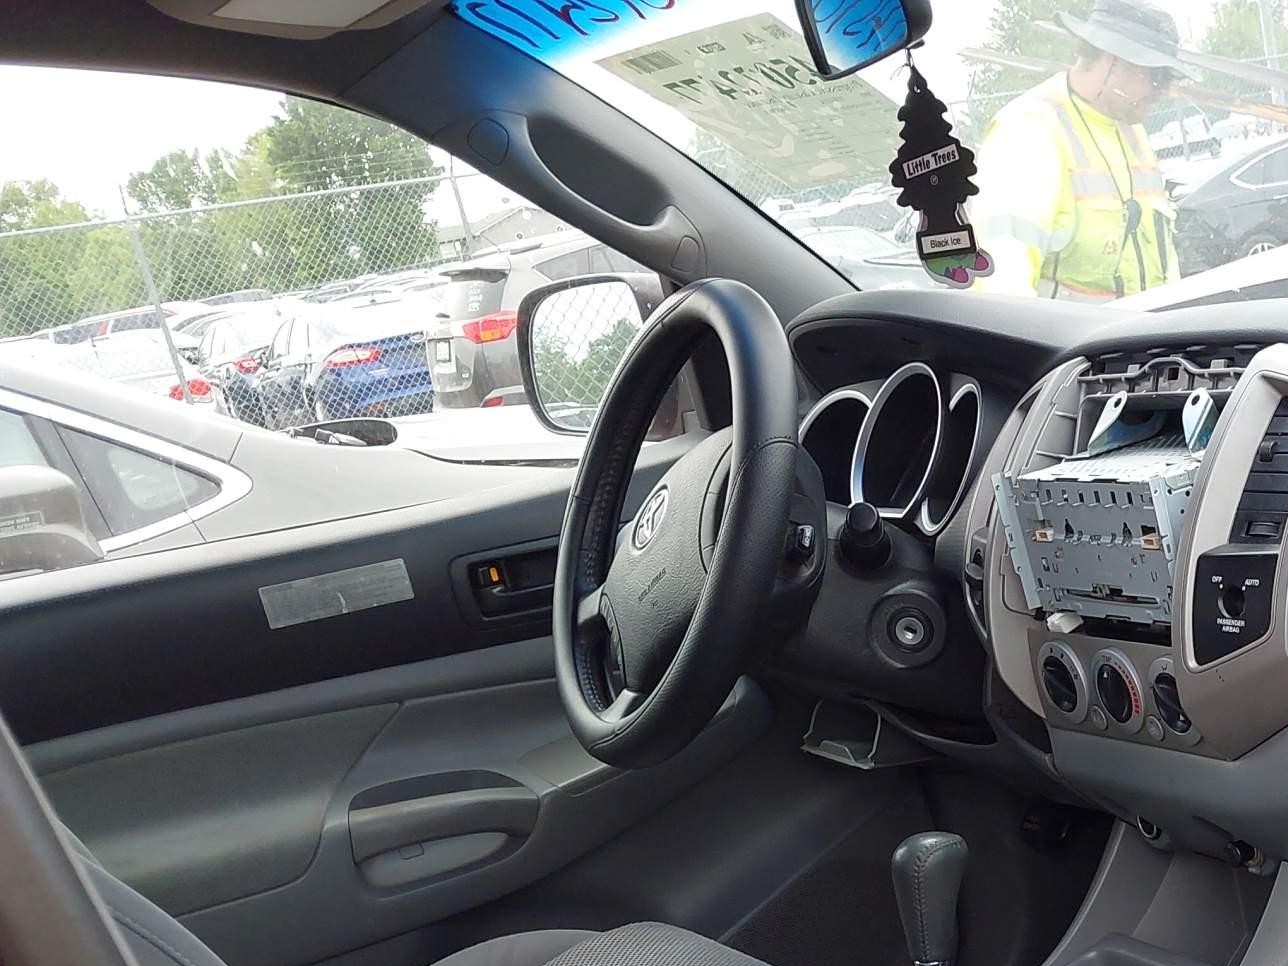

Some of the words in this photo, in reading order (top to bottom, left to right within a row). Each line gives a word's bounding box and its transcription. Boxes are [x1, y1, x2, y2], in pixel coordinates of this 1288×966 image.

[907, 159, 931, 176] Little
[931, 150, 957, 166] Trees
[930, 238, 949, 249] Black
[950, 237, 961, 246] Ice
[1245, 578, 1260, 586] AUTO
[1216, 618, 1245, 627] PASSENGER
